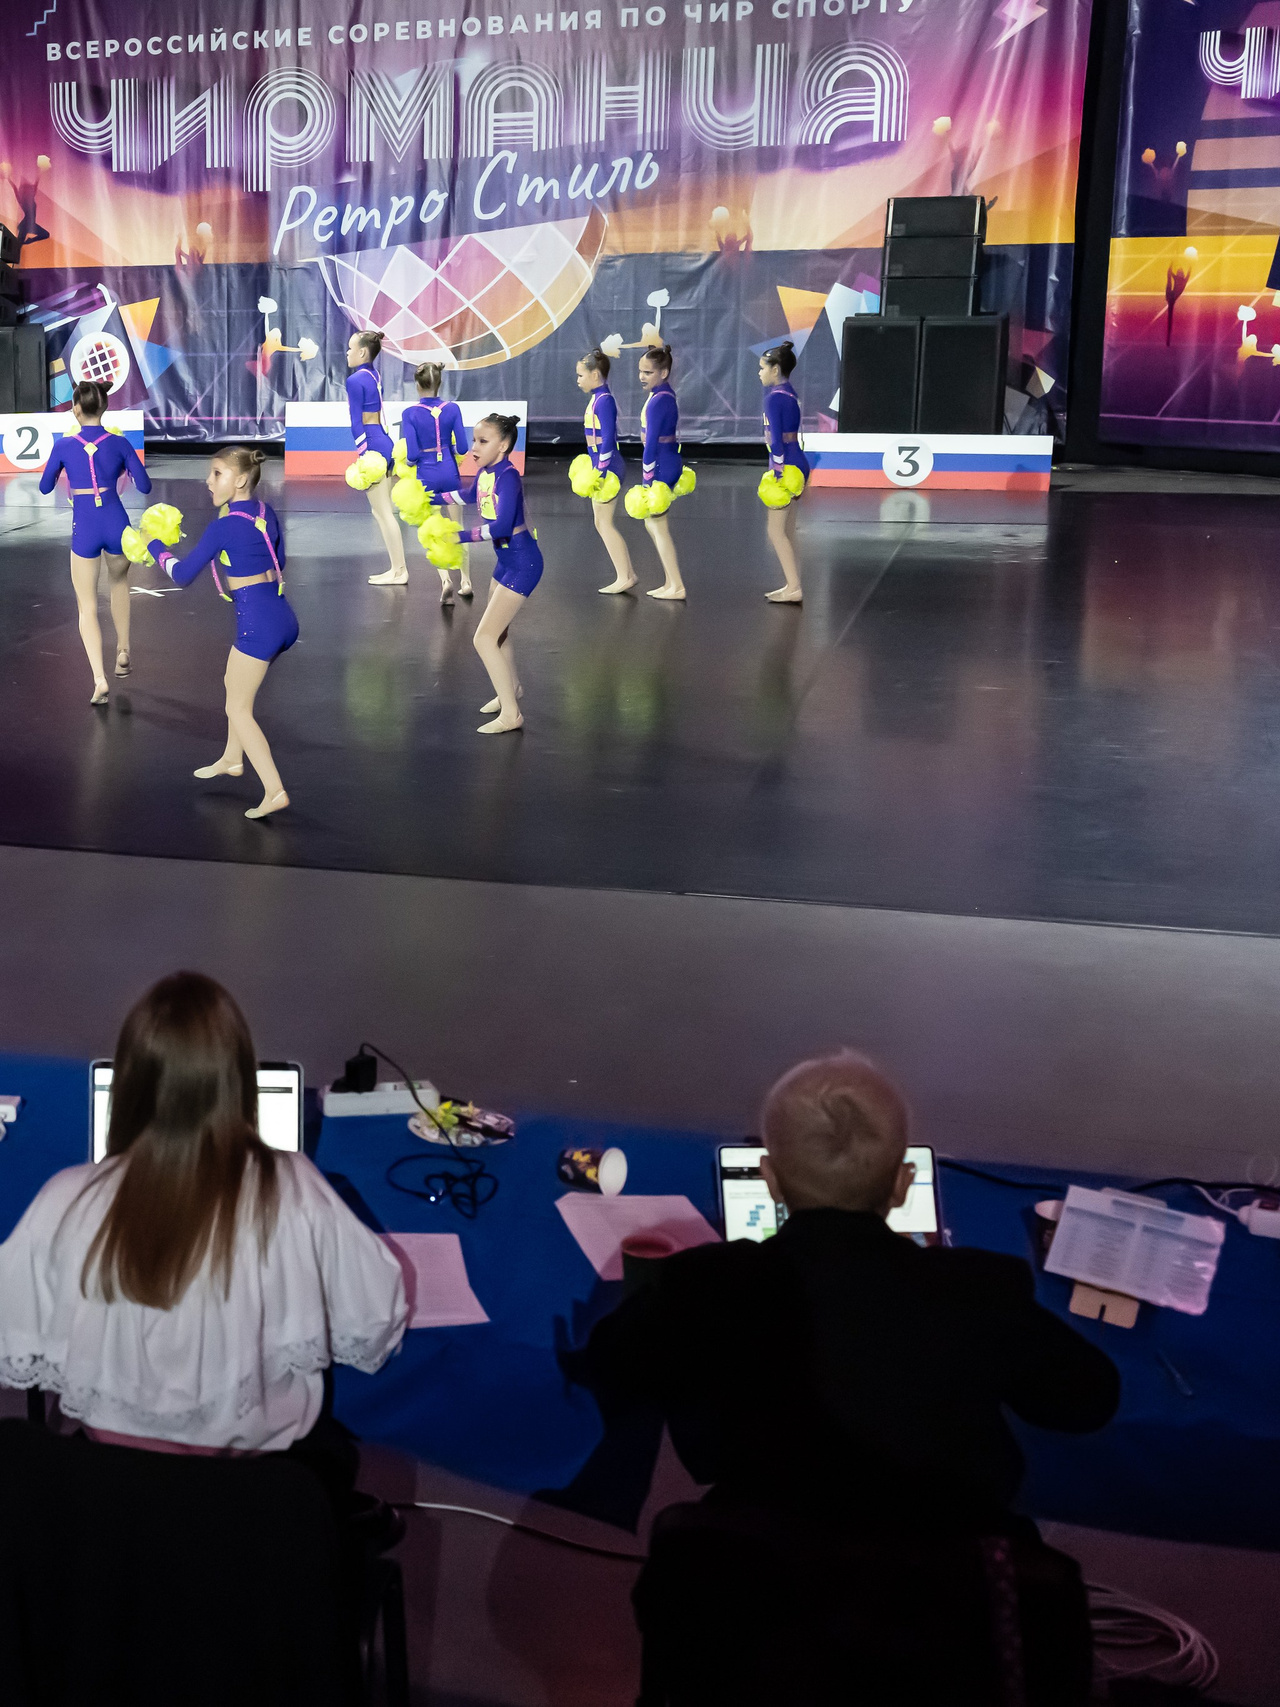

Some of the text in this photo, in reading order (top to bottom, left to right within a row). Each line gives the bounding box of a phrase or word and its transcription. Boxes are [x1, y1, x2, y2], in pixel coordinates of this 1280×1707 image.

[46, 26, 312, 62] ВСЕРОССИЙСКИЕ
[328, 8, 603, 45] СОРЕВНОВАНИЯ
[620, 6, 667, 28] ПО
[685, 1, 754, 25] ЧИР
[272, 150, 660, 256] Ретро Стиль
[15, 425, 41, 460] 2
[895, 445, 921, 478] 3
